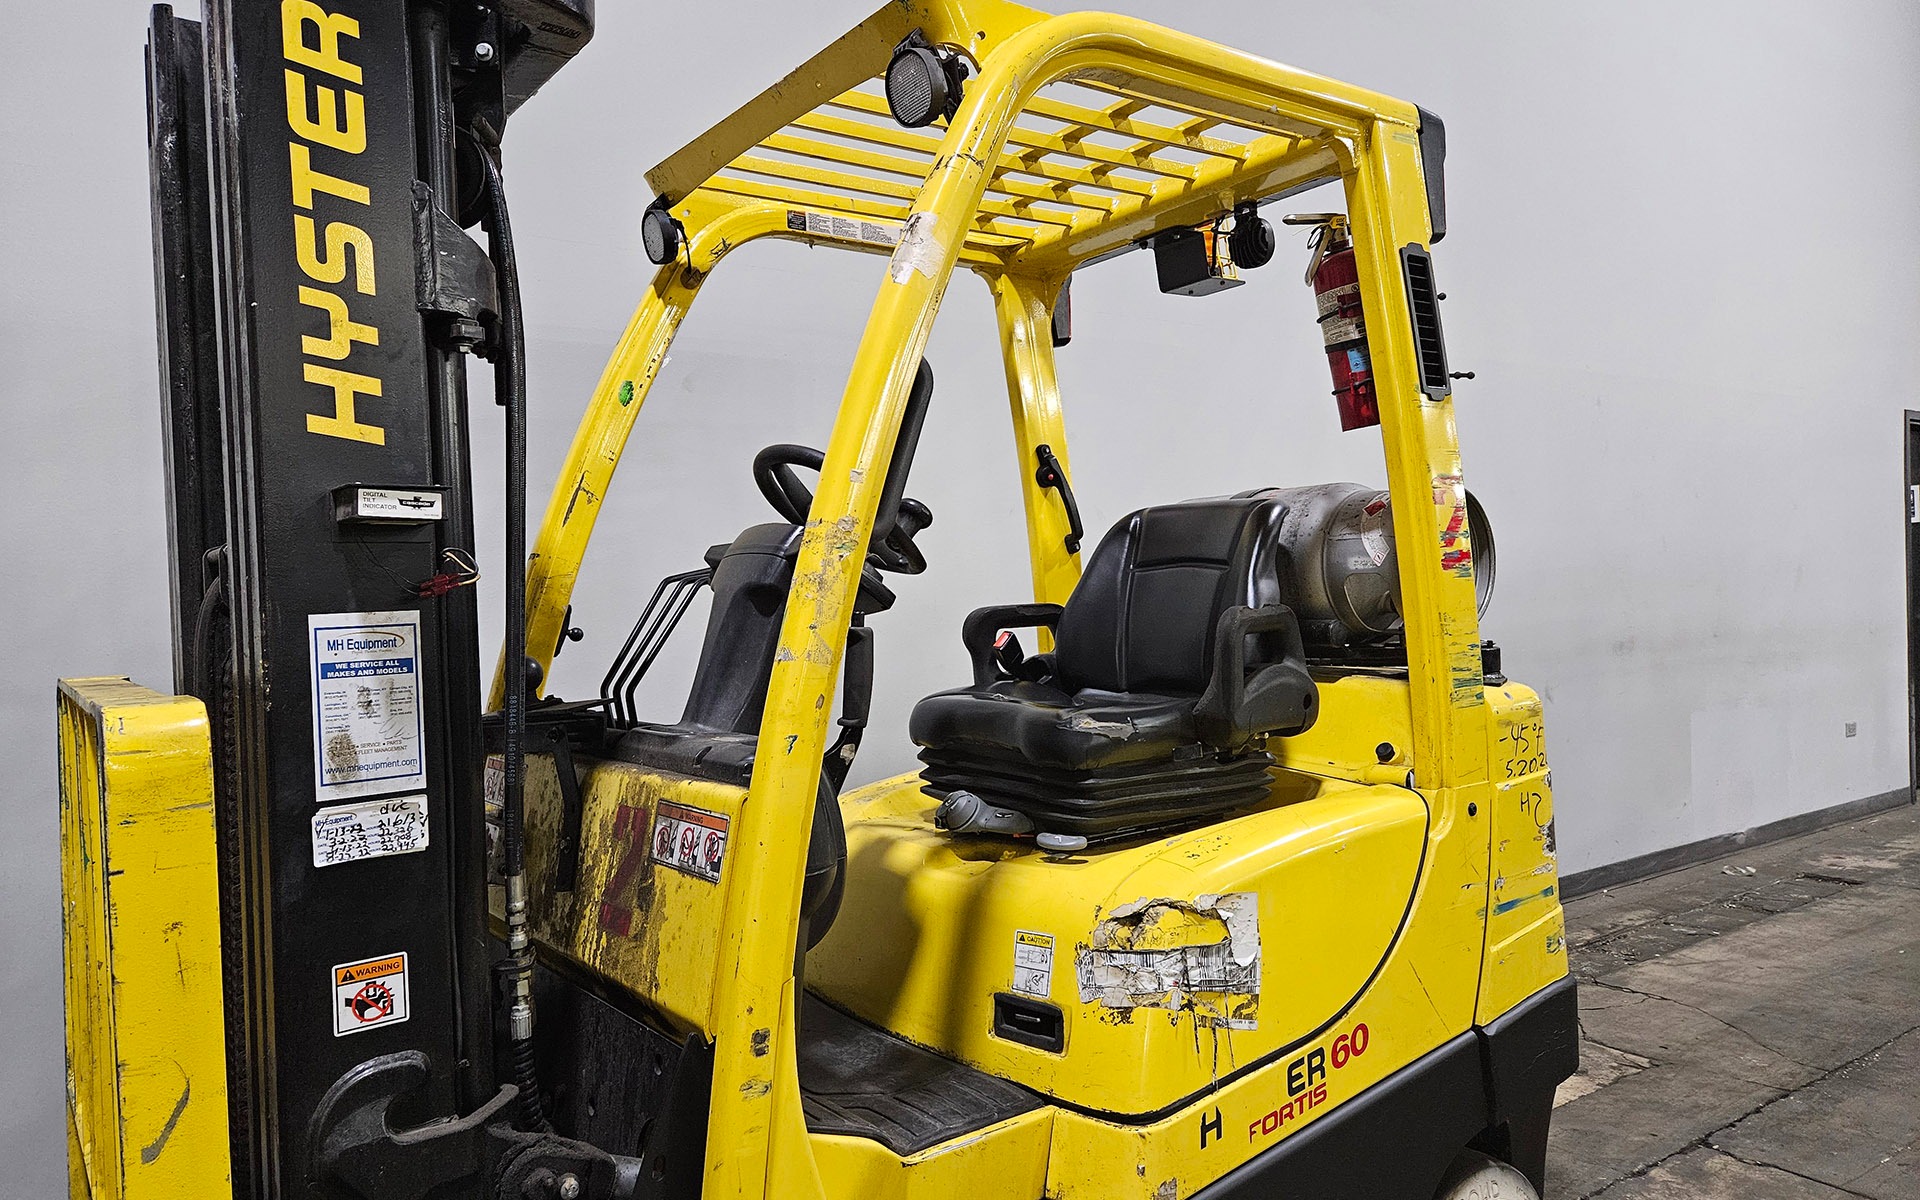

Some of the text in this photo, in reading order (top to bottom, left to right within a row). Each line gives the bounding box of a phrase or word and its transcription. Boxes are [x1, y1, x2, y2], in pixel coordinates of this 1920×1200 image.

[281, 0, 386, 446] HYSTER
[327, 637, 398, 652] MH Equipment
[327, 666, 408, 678] MAKES AND MODELS
[349, 661, 384, 669] SERVICE
[360, 741, 381, 749] SERVICE
[374, 745, 408, 754] MANAGEMENT
[325, 758, 418, 775] www.mhequipment.com
[1026, 936, 1050, 945] CAUTION
[355, 961, 400, 977] WARNING
[1286, 1023, 1369, 1097] ER 60
[1249, 1082, 1328, 1144] FORTIS
